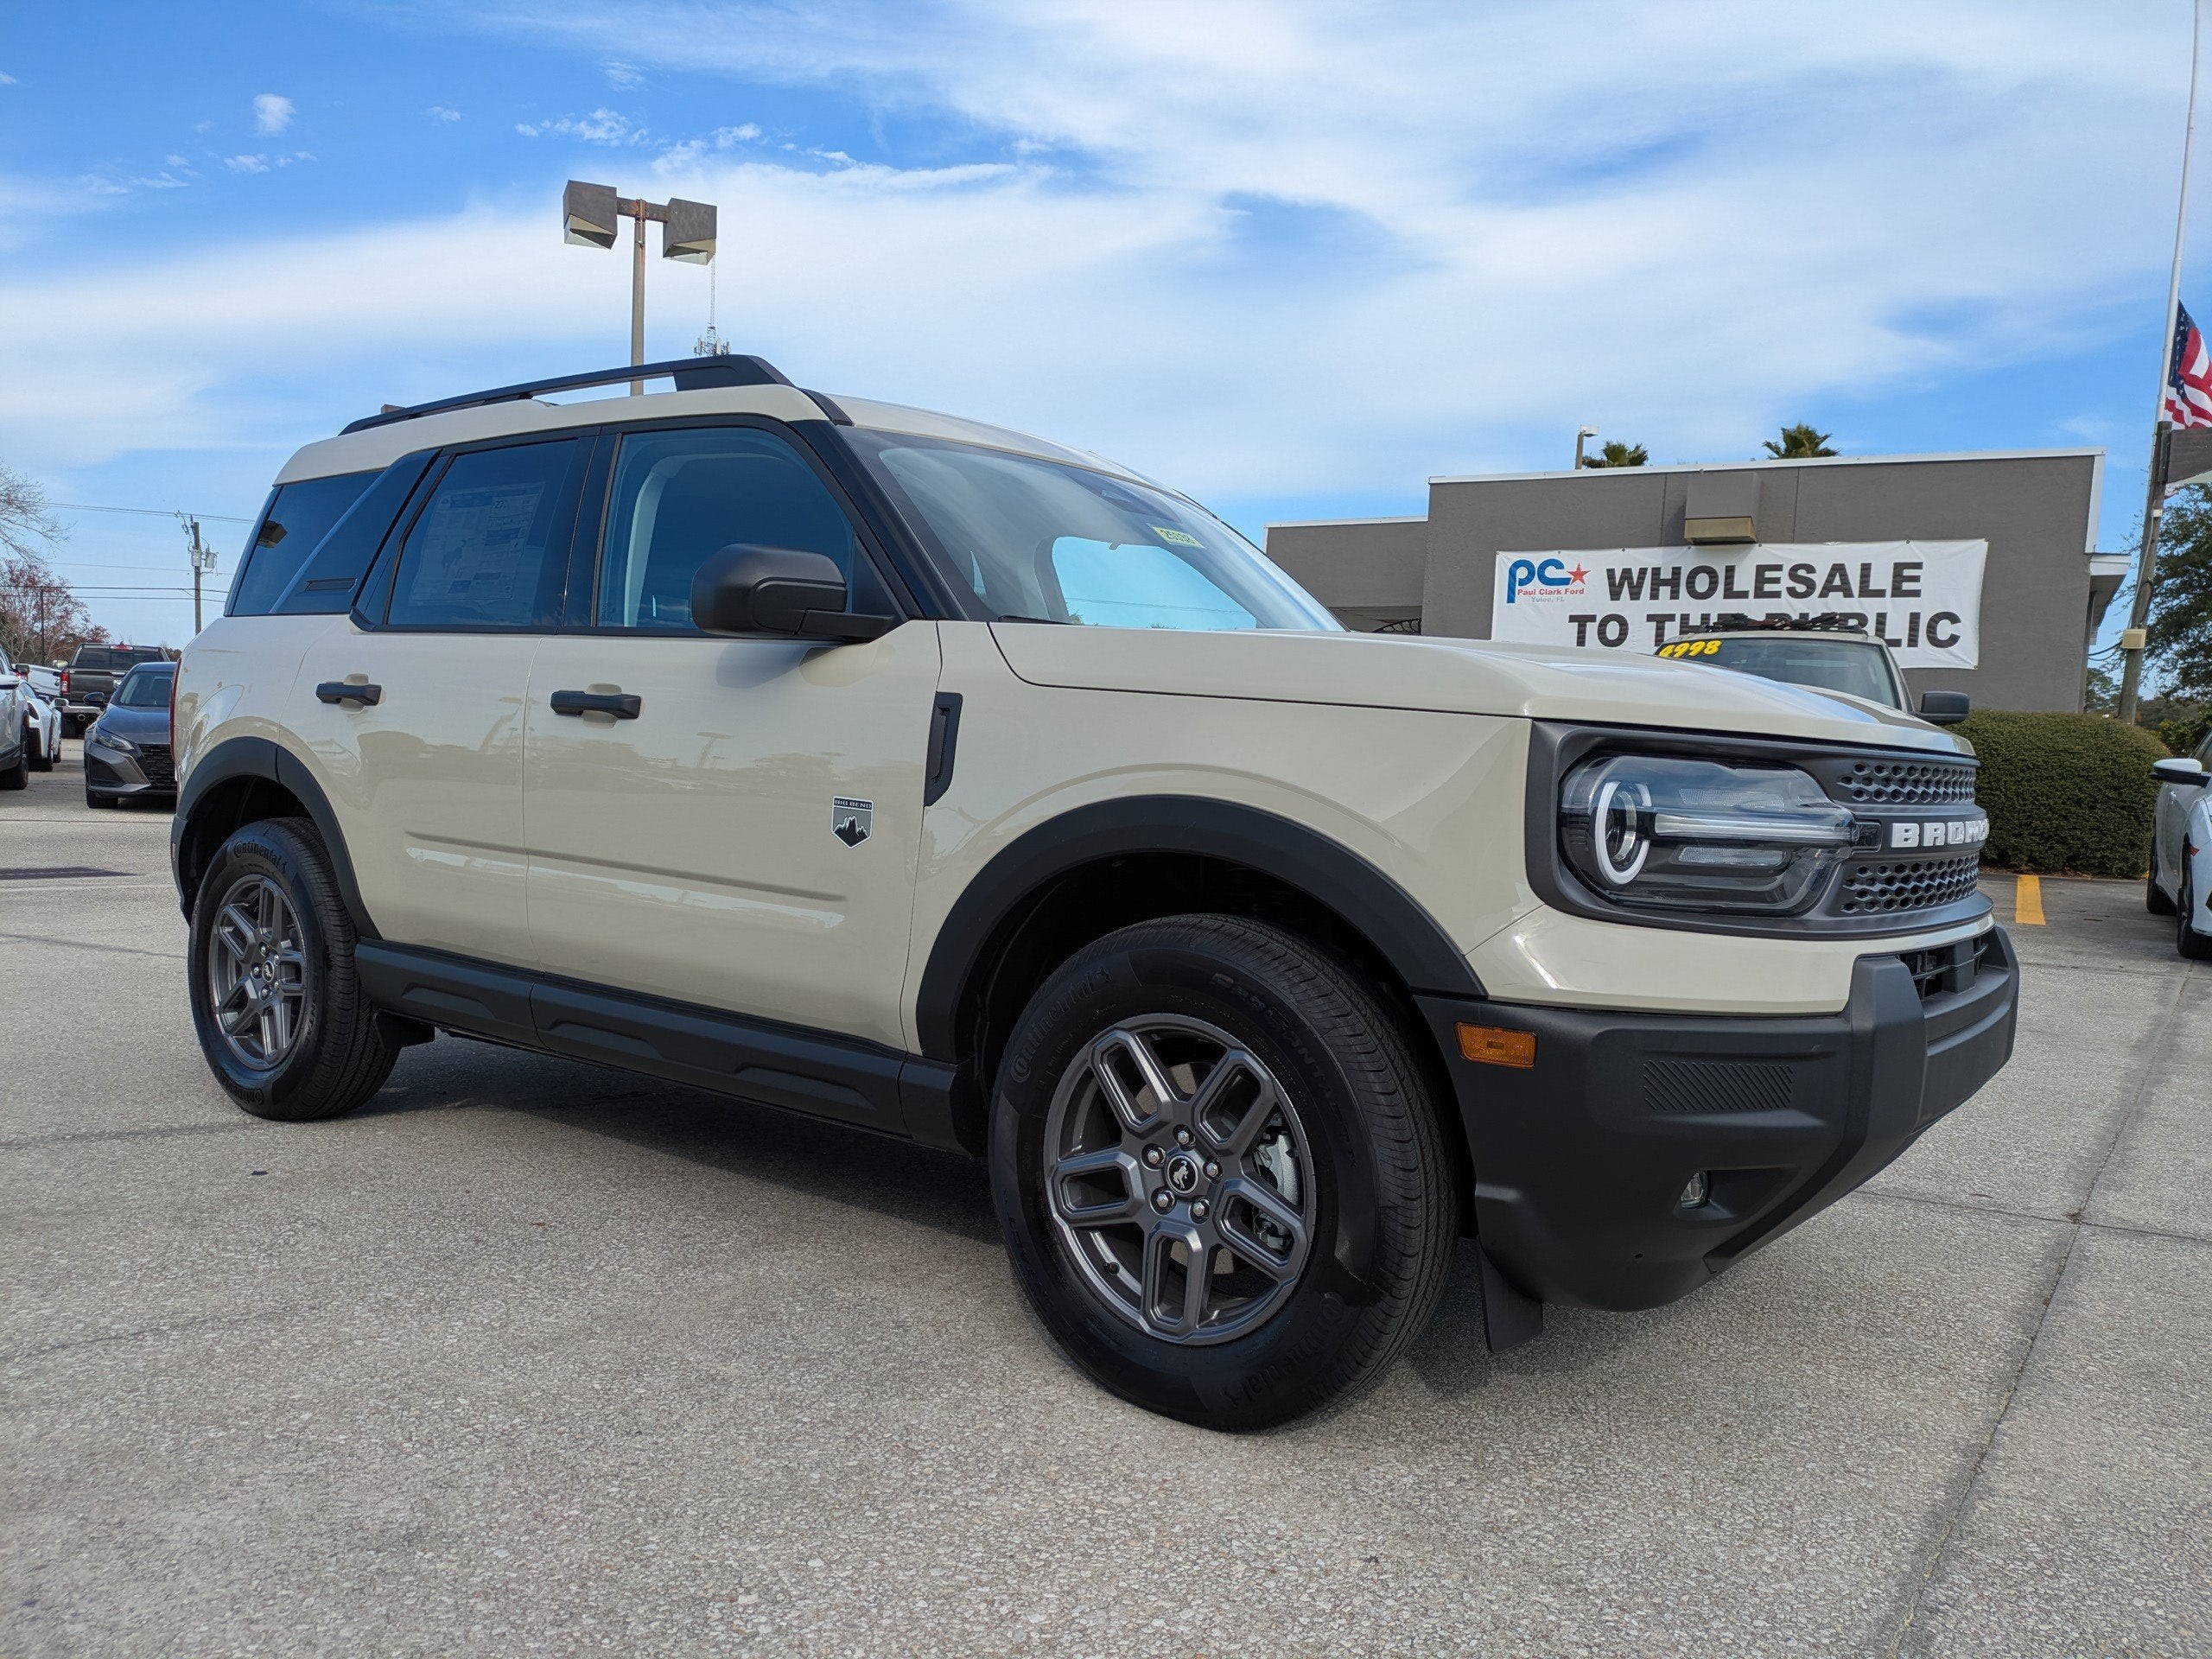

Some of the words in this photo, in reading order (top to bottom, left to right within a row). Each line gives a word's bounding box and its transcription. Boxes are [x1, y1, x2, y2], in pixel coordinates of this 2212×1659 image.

[1606, 562, 1923, 601] WHOLESALE
[1568, 613, 1629, 648] TO
[1646, 613, 1747, 647] TH
[1765, 611, 1961, 648] LIC
[1891, 818, 1989, 848] BRON
